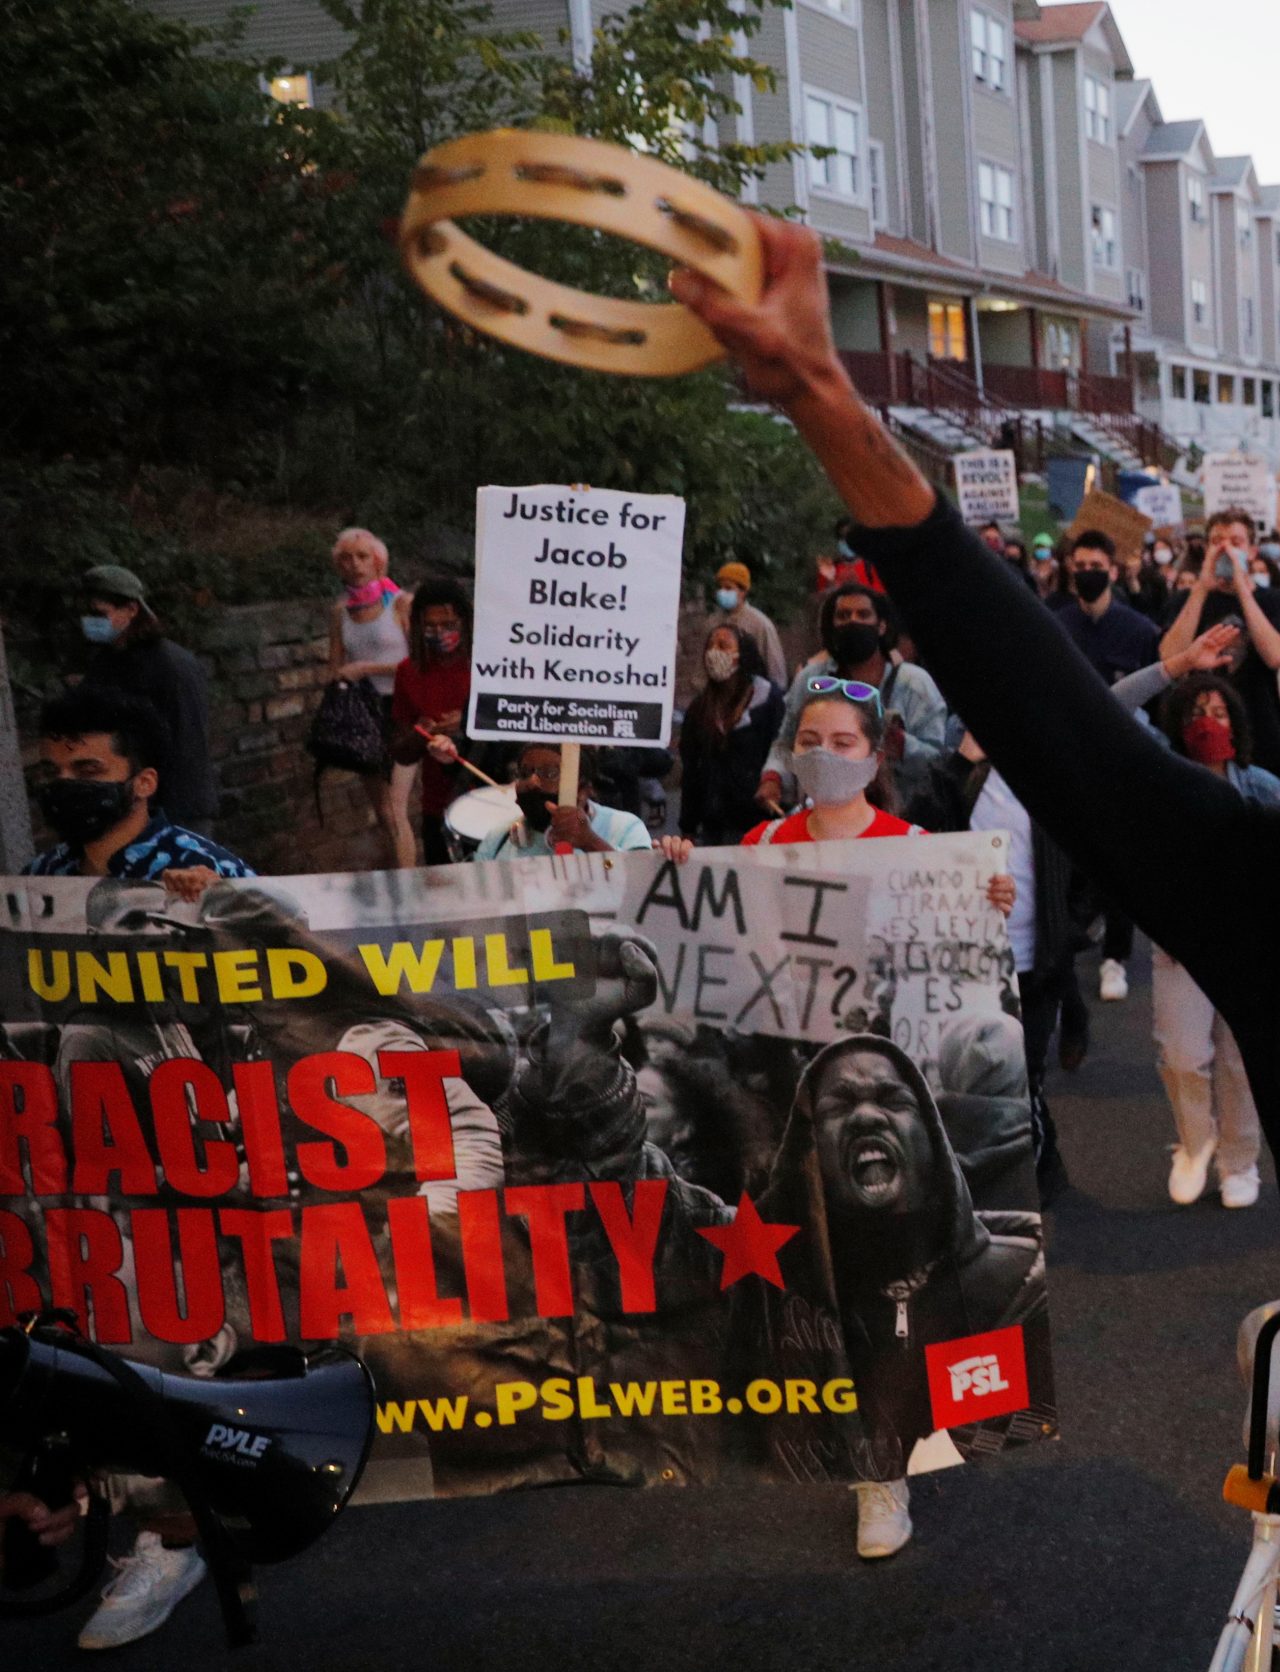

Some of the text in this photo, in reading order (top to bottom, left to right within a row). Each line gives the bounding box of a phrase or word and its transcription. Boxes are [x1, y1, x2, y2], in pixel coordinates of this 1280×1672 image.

[503, 493, 667, 531] Justice for
[534, 538, 628, 569] Jacob
[529, 579, 628, 611] Blake!
[509, 622, 640, 657] Solidarity
[476, 657, 668, 687] with Kenosha!
[497, 698, 638, 721] Party for Socialism
[497, 717, 528, 731] and
[531, 716, 608, 736] Liberation
[635, 860, 848, 948] AM I
[890, 893, 996, 912] TIRANI
[27, 928, 576, 1004] UNITED WILL
[0, 1049, 463, 1199] RACIST
[948, 1358, 1010, 1403] PSL
[205, 1423, 272, 1459] PYLE
